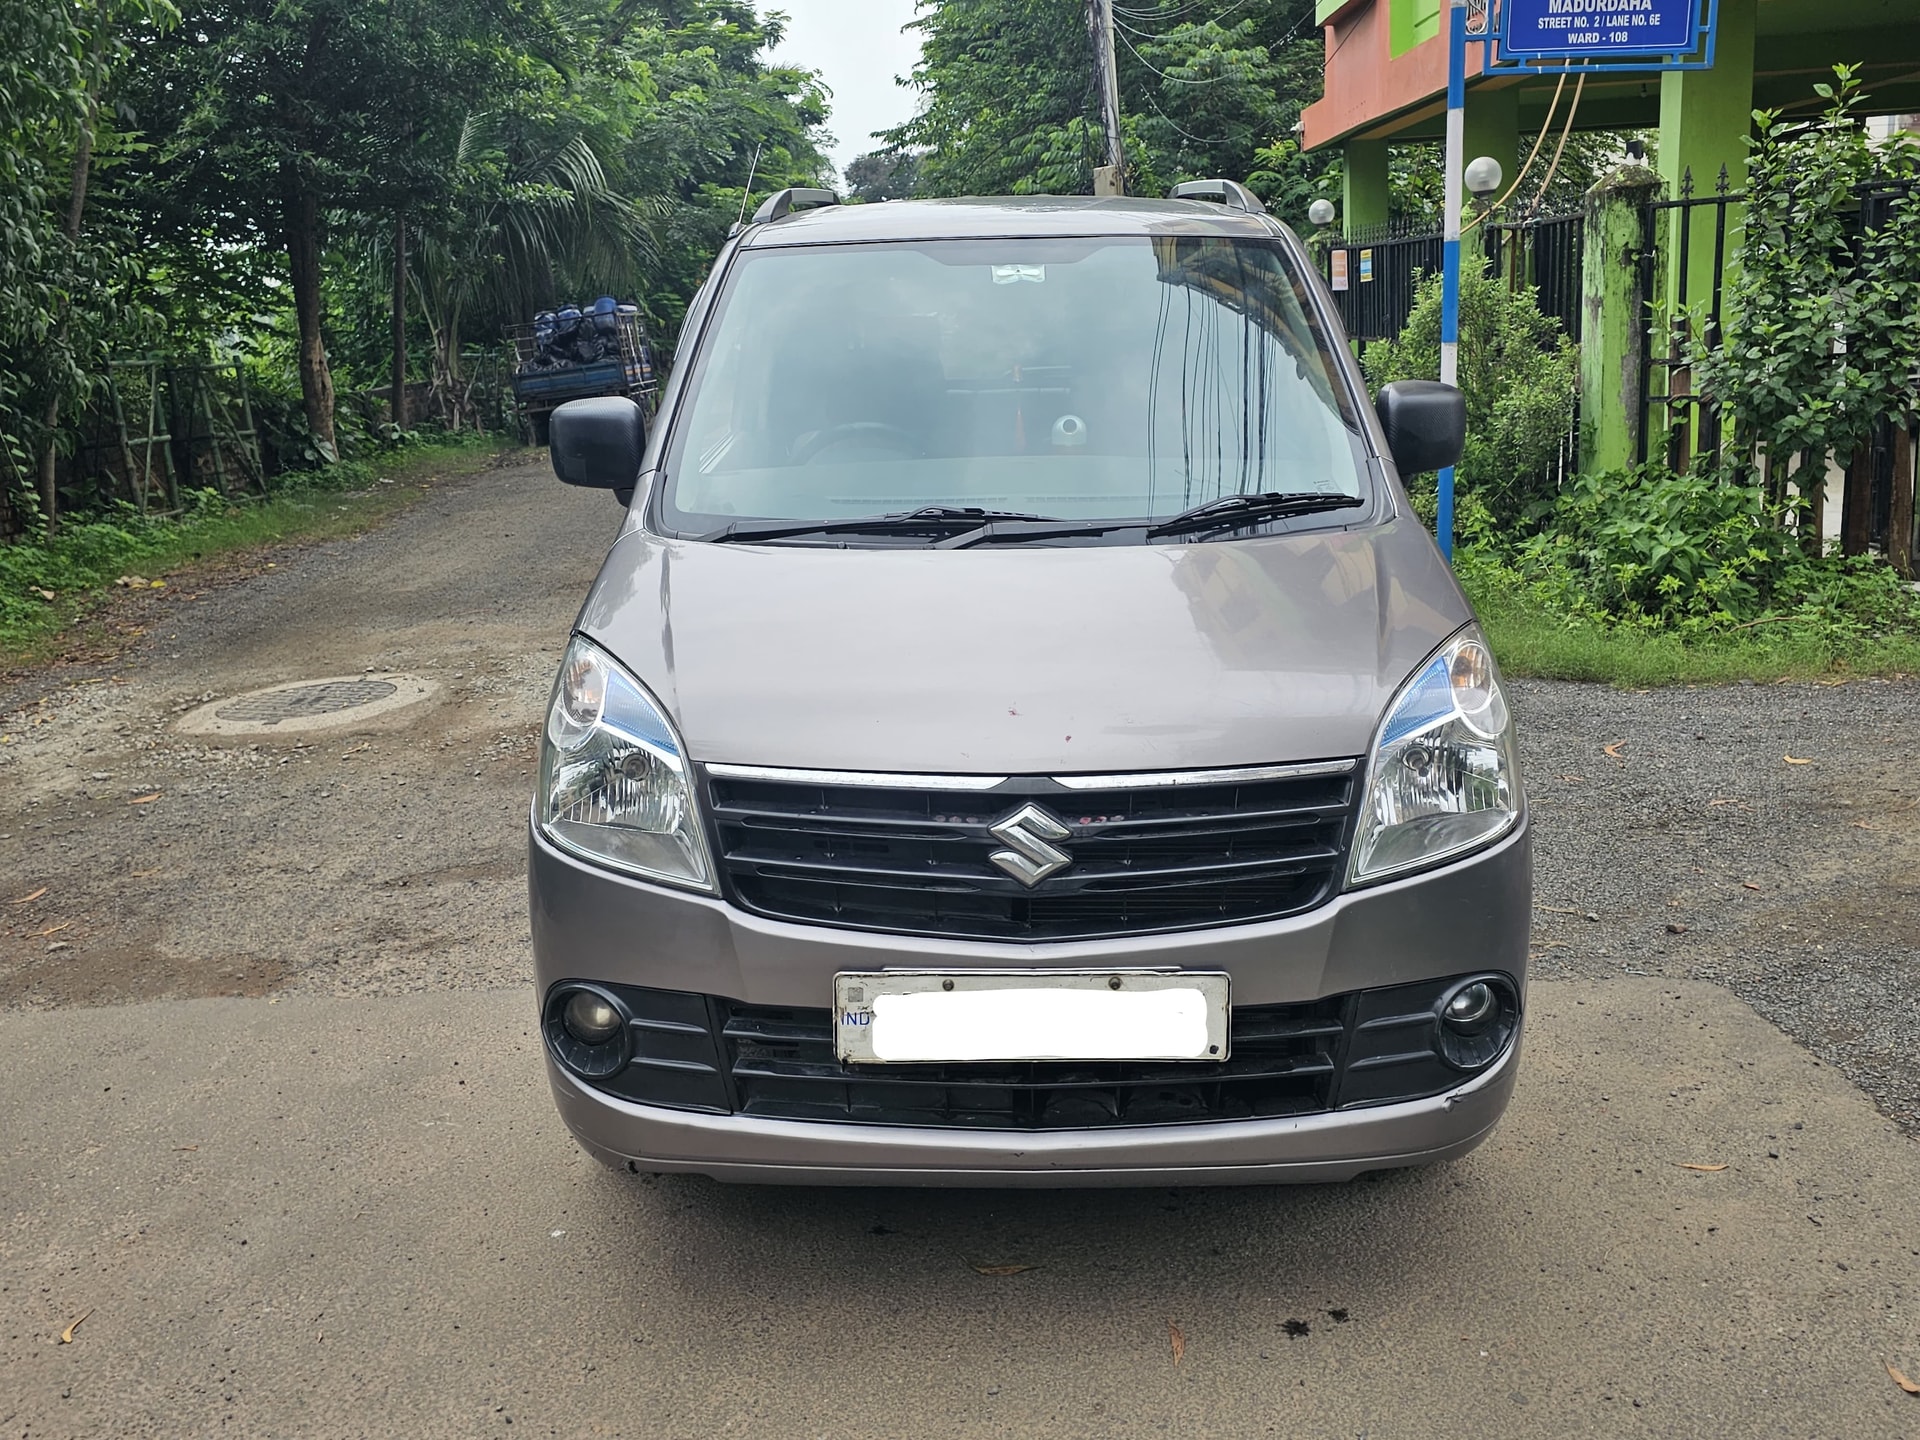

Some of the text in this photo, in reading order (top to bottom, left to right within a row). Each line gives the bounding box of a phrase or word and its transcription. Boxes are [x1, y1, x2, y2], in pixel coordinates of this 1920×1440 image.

[1548, 0, 1652, 13] MADURDAHA
[1538, 17, 1572, 29] STREET
[1574, 16, 1589, 28] NO.
[1593, 16, 1600, 27] 2
[1606, 15, 1629, 27] LANE
[1631, 14, 1647, 26] NO.
[1649, 14, 1661, 25] 6E
[1567, 33, 1600, 44] WARD
[1608, 31, 1628, 42] 108
[841, 1011, 871, 1026] IND
